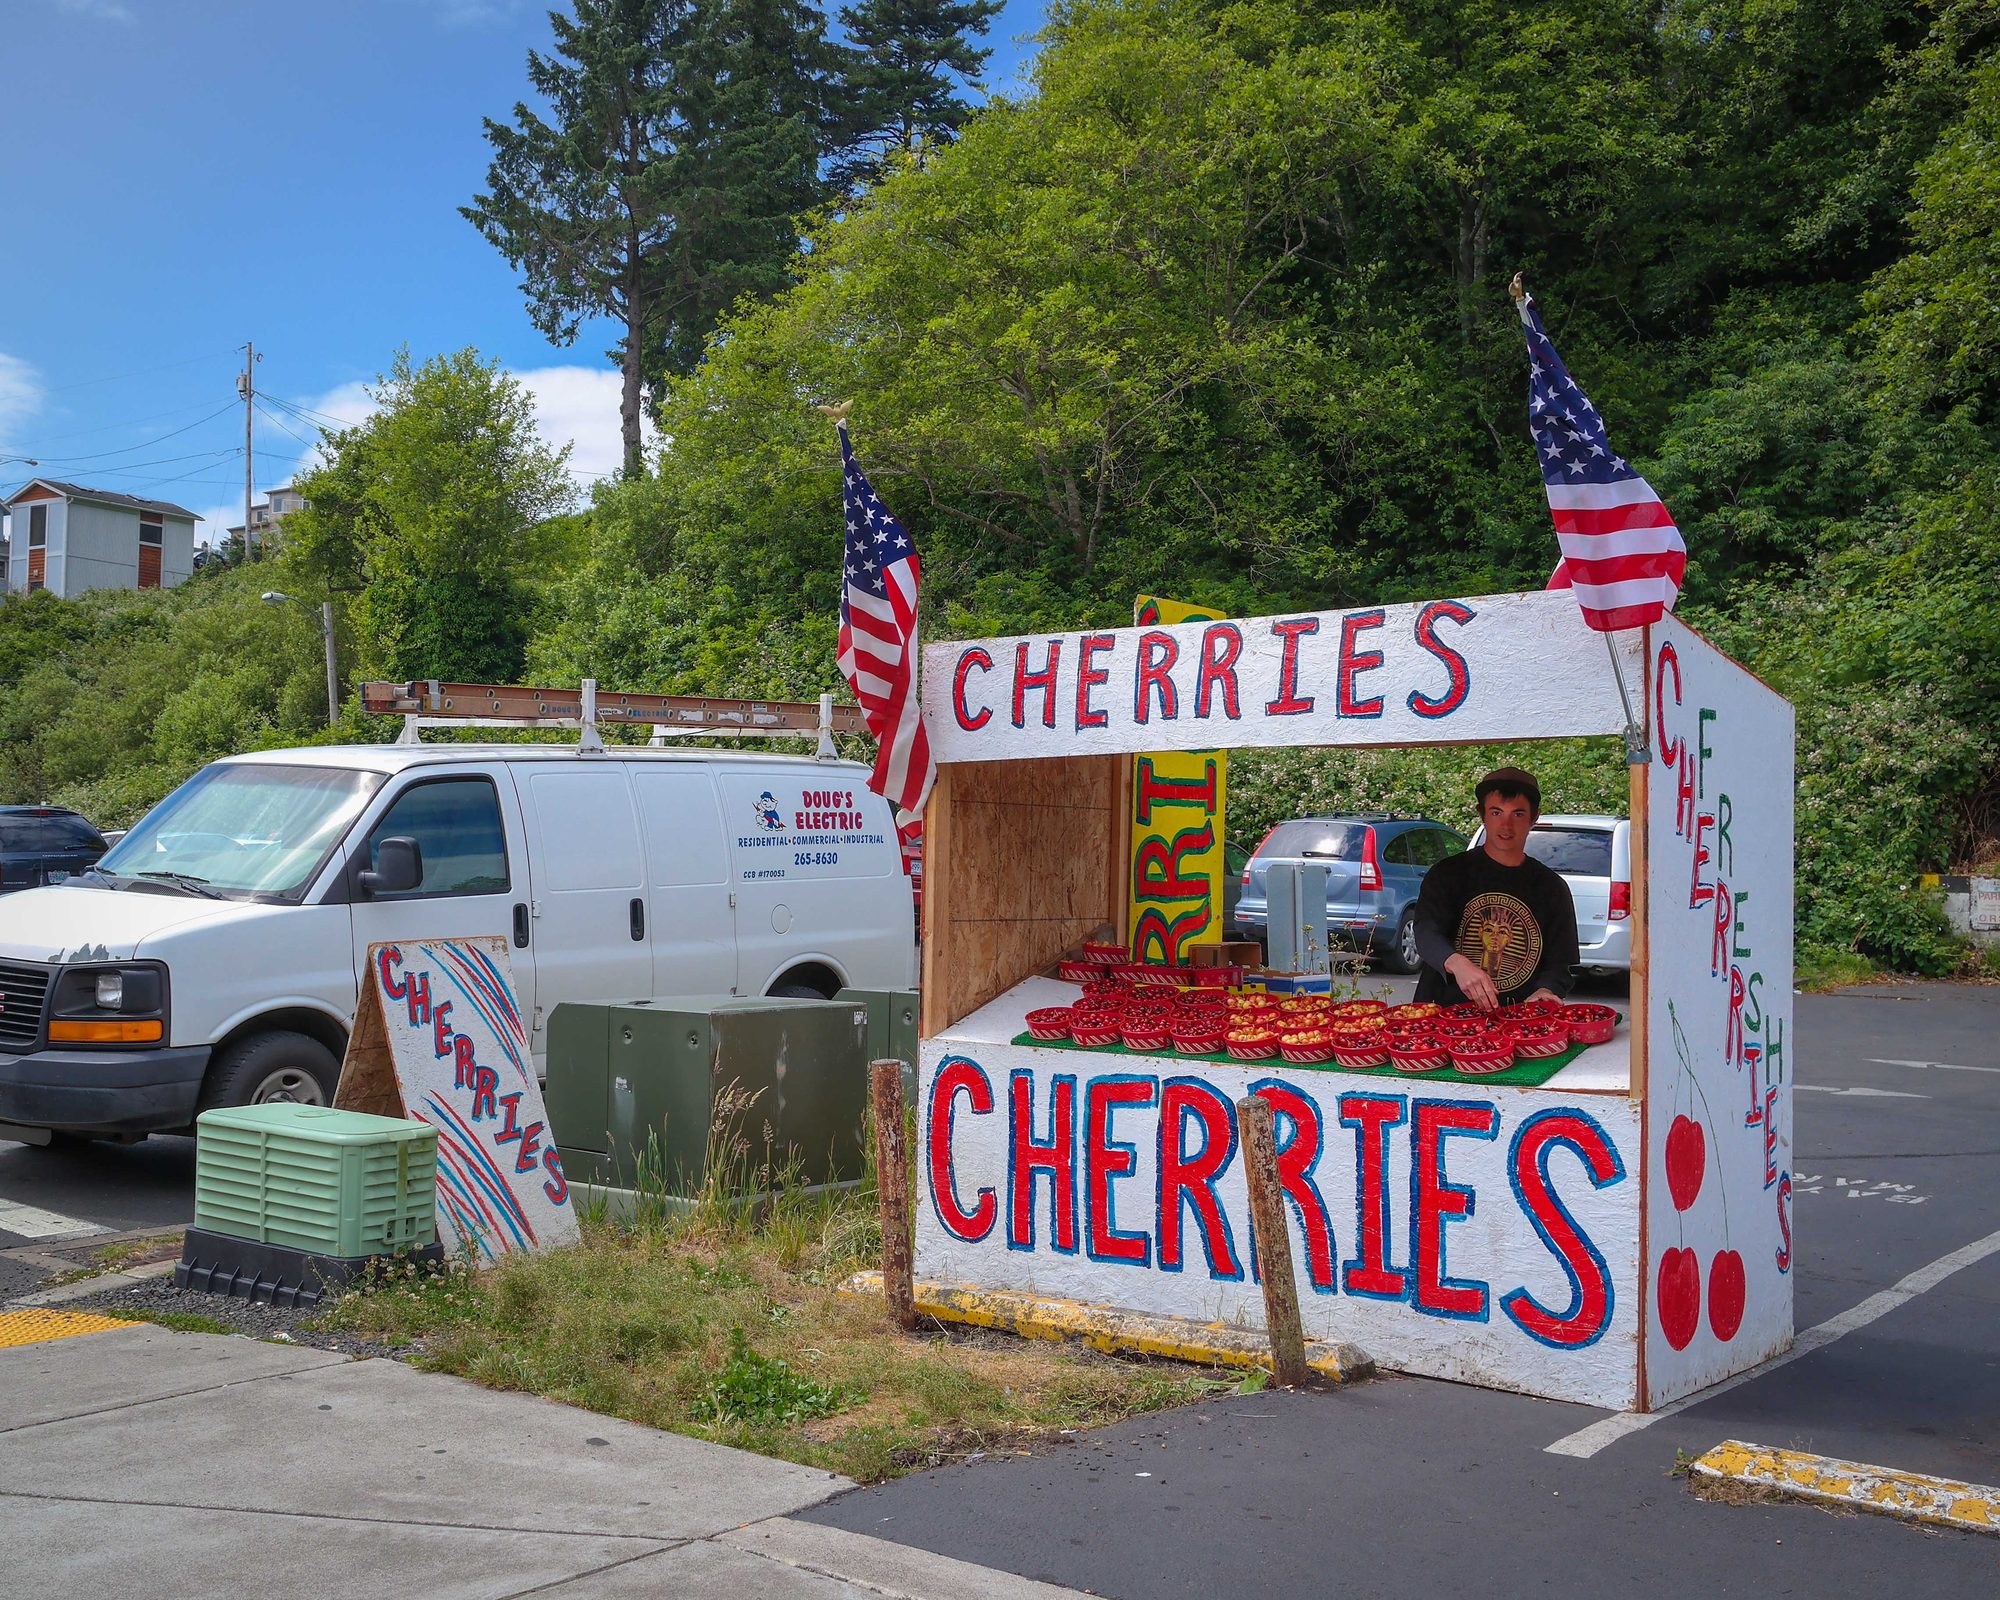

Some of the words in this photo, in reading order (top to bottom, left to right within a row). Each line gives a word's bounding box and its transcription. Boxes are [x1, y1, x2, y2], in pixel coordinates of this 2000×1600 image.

[952, 599, 1477, 733] CHERRIES
[794, 852, 838, 865] 265-8630
[795, 811, 863, 831] ELECTRIC
[802, 790, 853, 809] DOUG'S
[743, 870, 756, 878] CCB
[1698, 707, 1785, 1086] FRESH
[1656, 640, 1792, 1274] CHERRIES
[378, 946, 569, 1206] CHERRIES
[926, 1054, 1627, 1350] CHERRIES
